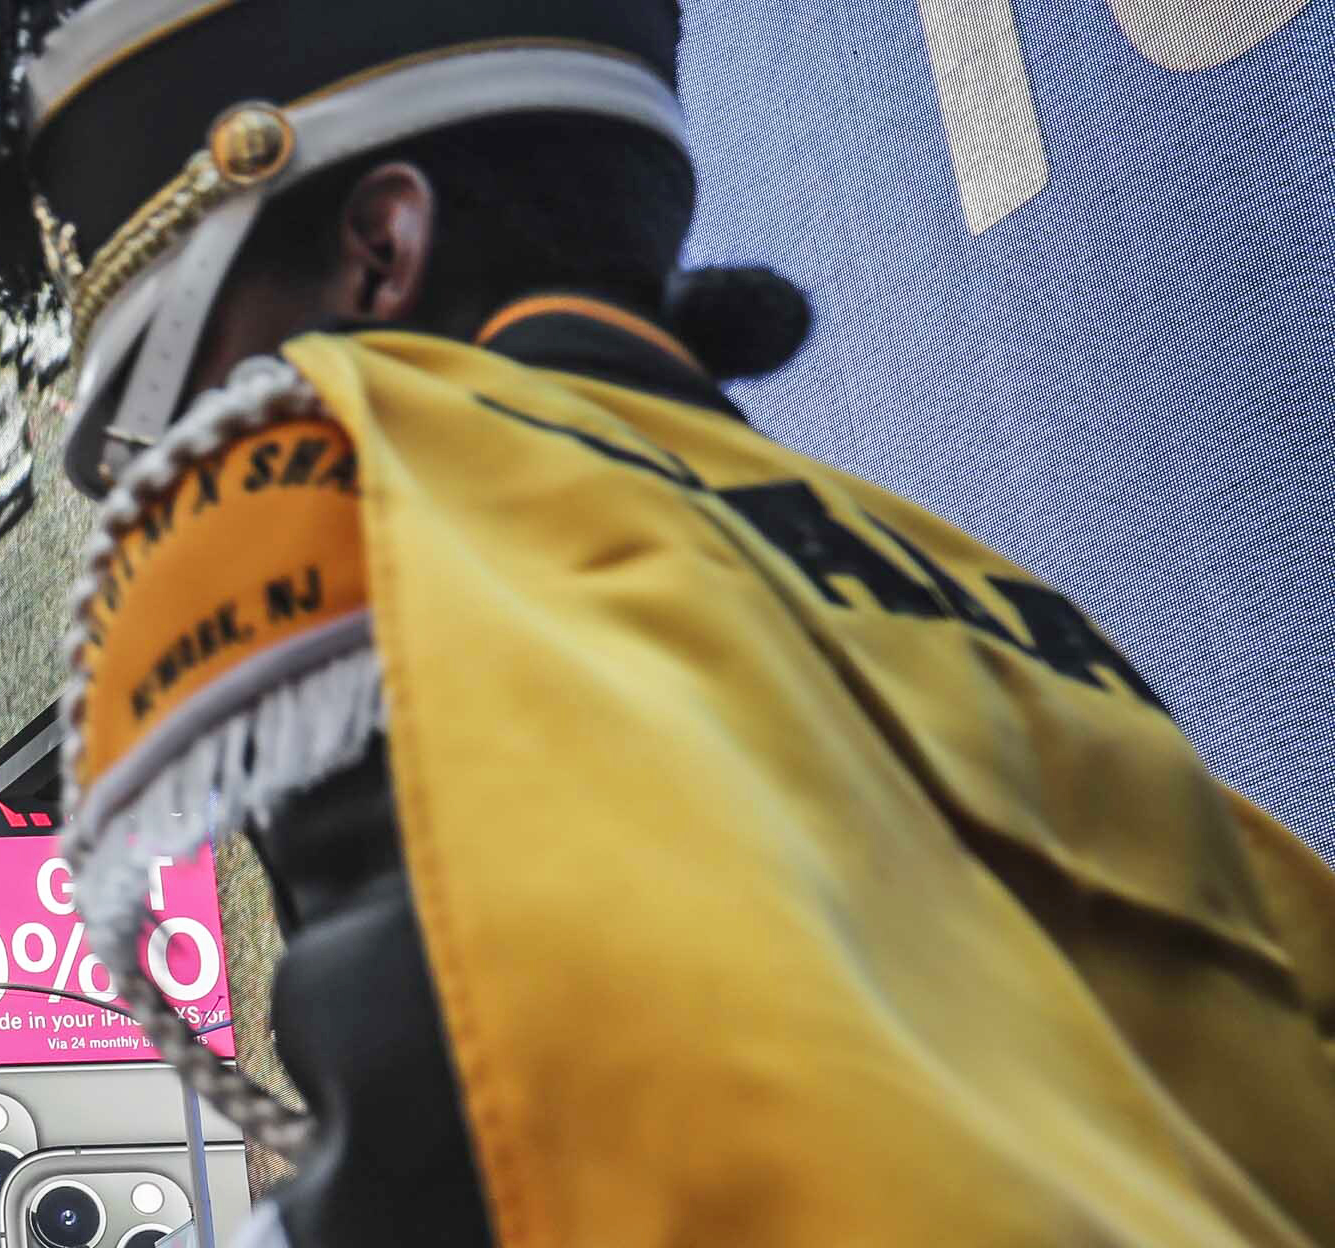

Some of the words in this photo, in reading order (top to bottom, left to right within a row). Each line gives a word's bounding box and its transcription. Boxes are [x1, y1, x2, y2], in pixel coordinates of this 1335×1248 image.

[36, 855, 174, 915] GT
[29, 1011, 46, 1028] in
[52, 1013, 94, 1032] your
[206, 1009, 226, 1024] or
[47, 1036, 68, 1050] Via
[71, 1036, 86, 1049] 24
[90, 1035, 139, 1050] monthly
